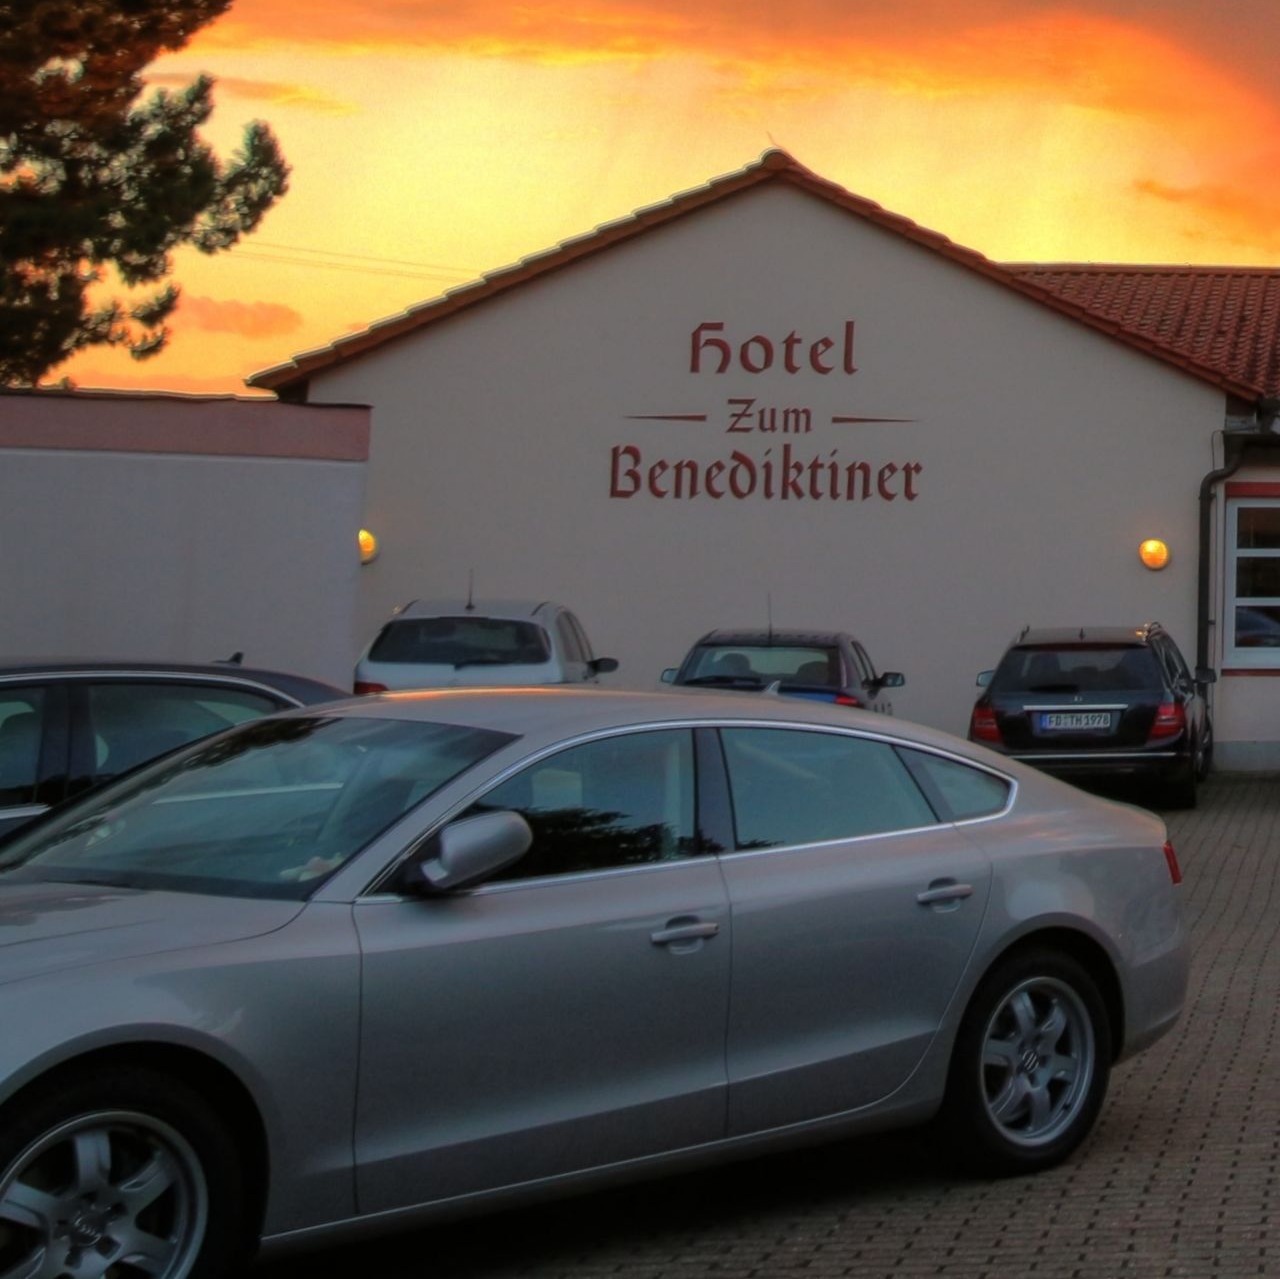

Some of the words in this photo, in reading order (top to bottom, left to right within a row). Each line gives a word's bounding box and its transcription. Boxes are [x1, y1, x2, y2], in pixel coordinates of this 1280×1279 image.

[689, 320, 859, 375] Hotel
[725, 397, 813, 434] Zum
[609, 443, 923, 501] Benediktiner
